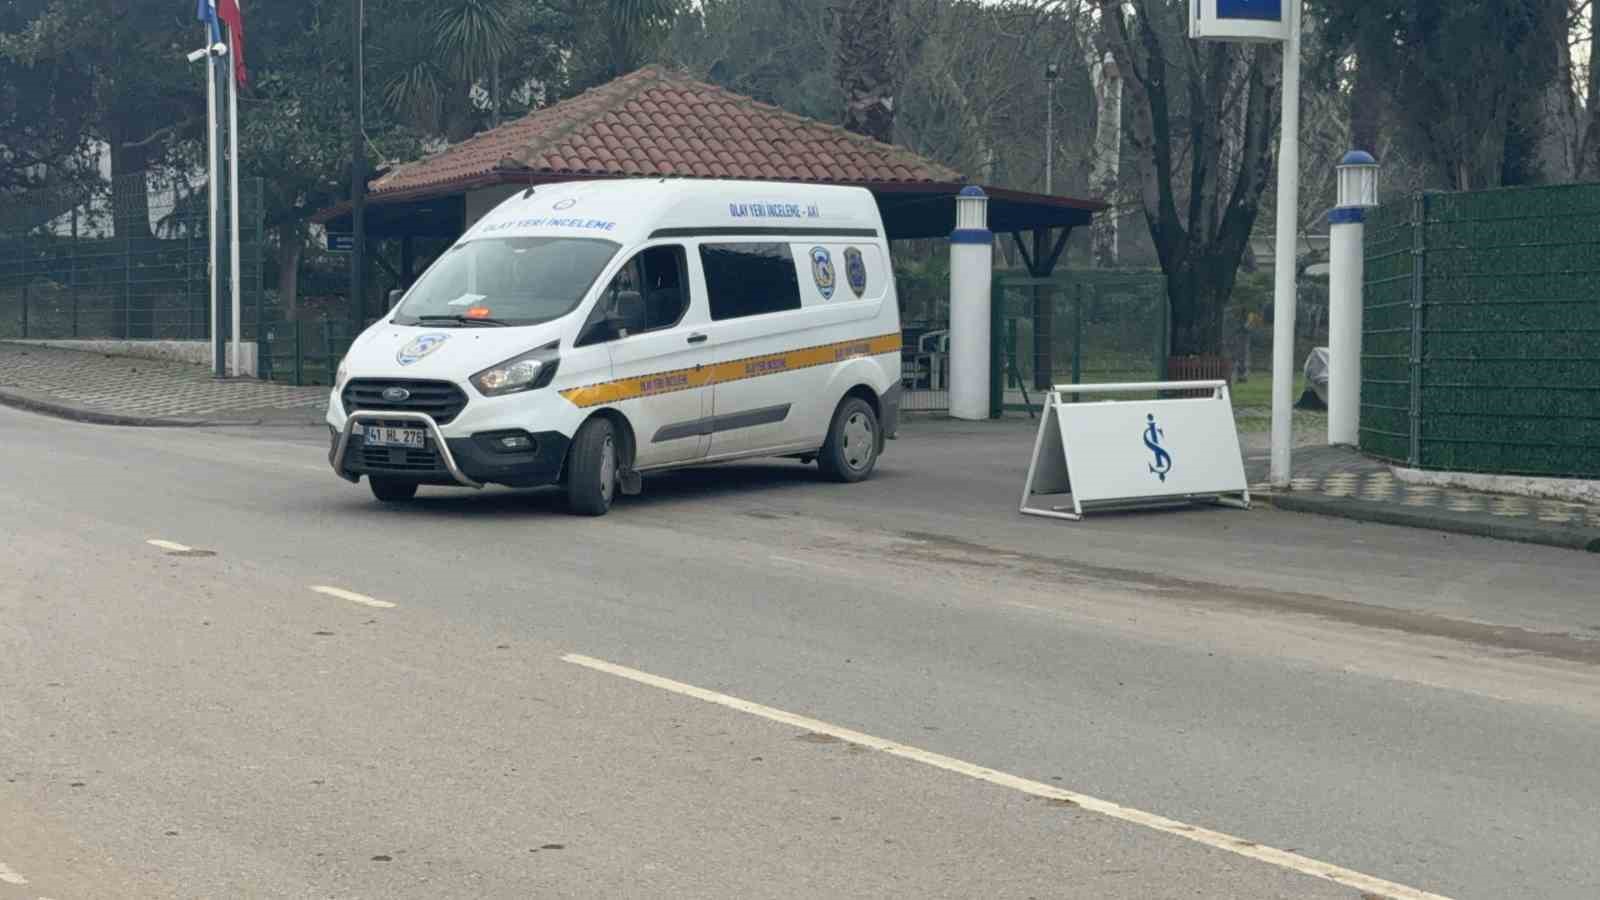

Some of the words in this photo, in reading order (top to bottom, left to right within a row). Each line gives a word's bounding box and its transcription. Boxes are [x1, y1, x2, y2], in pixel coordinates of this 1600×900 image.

[729, 203, 748, 217] OLAY
[768, 202, 801, 218] İNCELEME
[548, 217, 616, 232] İNCELEME
[370, 428, 381, 440] 41
[387, 429, 399, 441] HL
